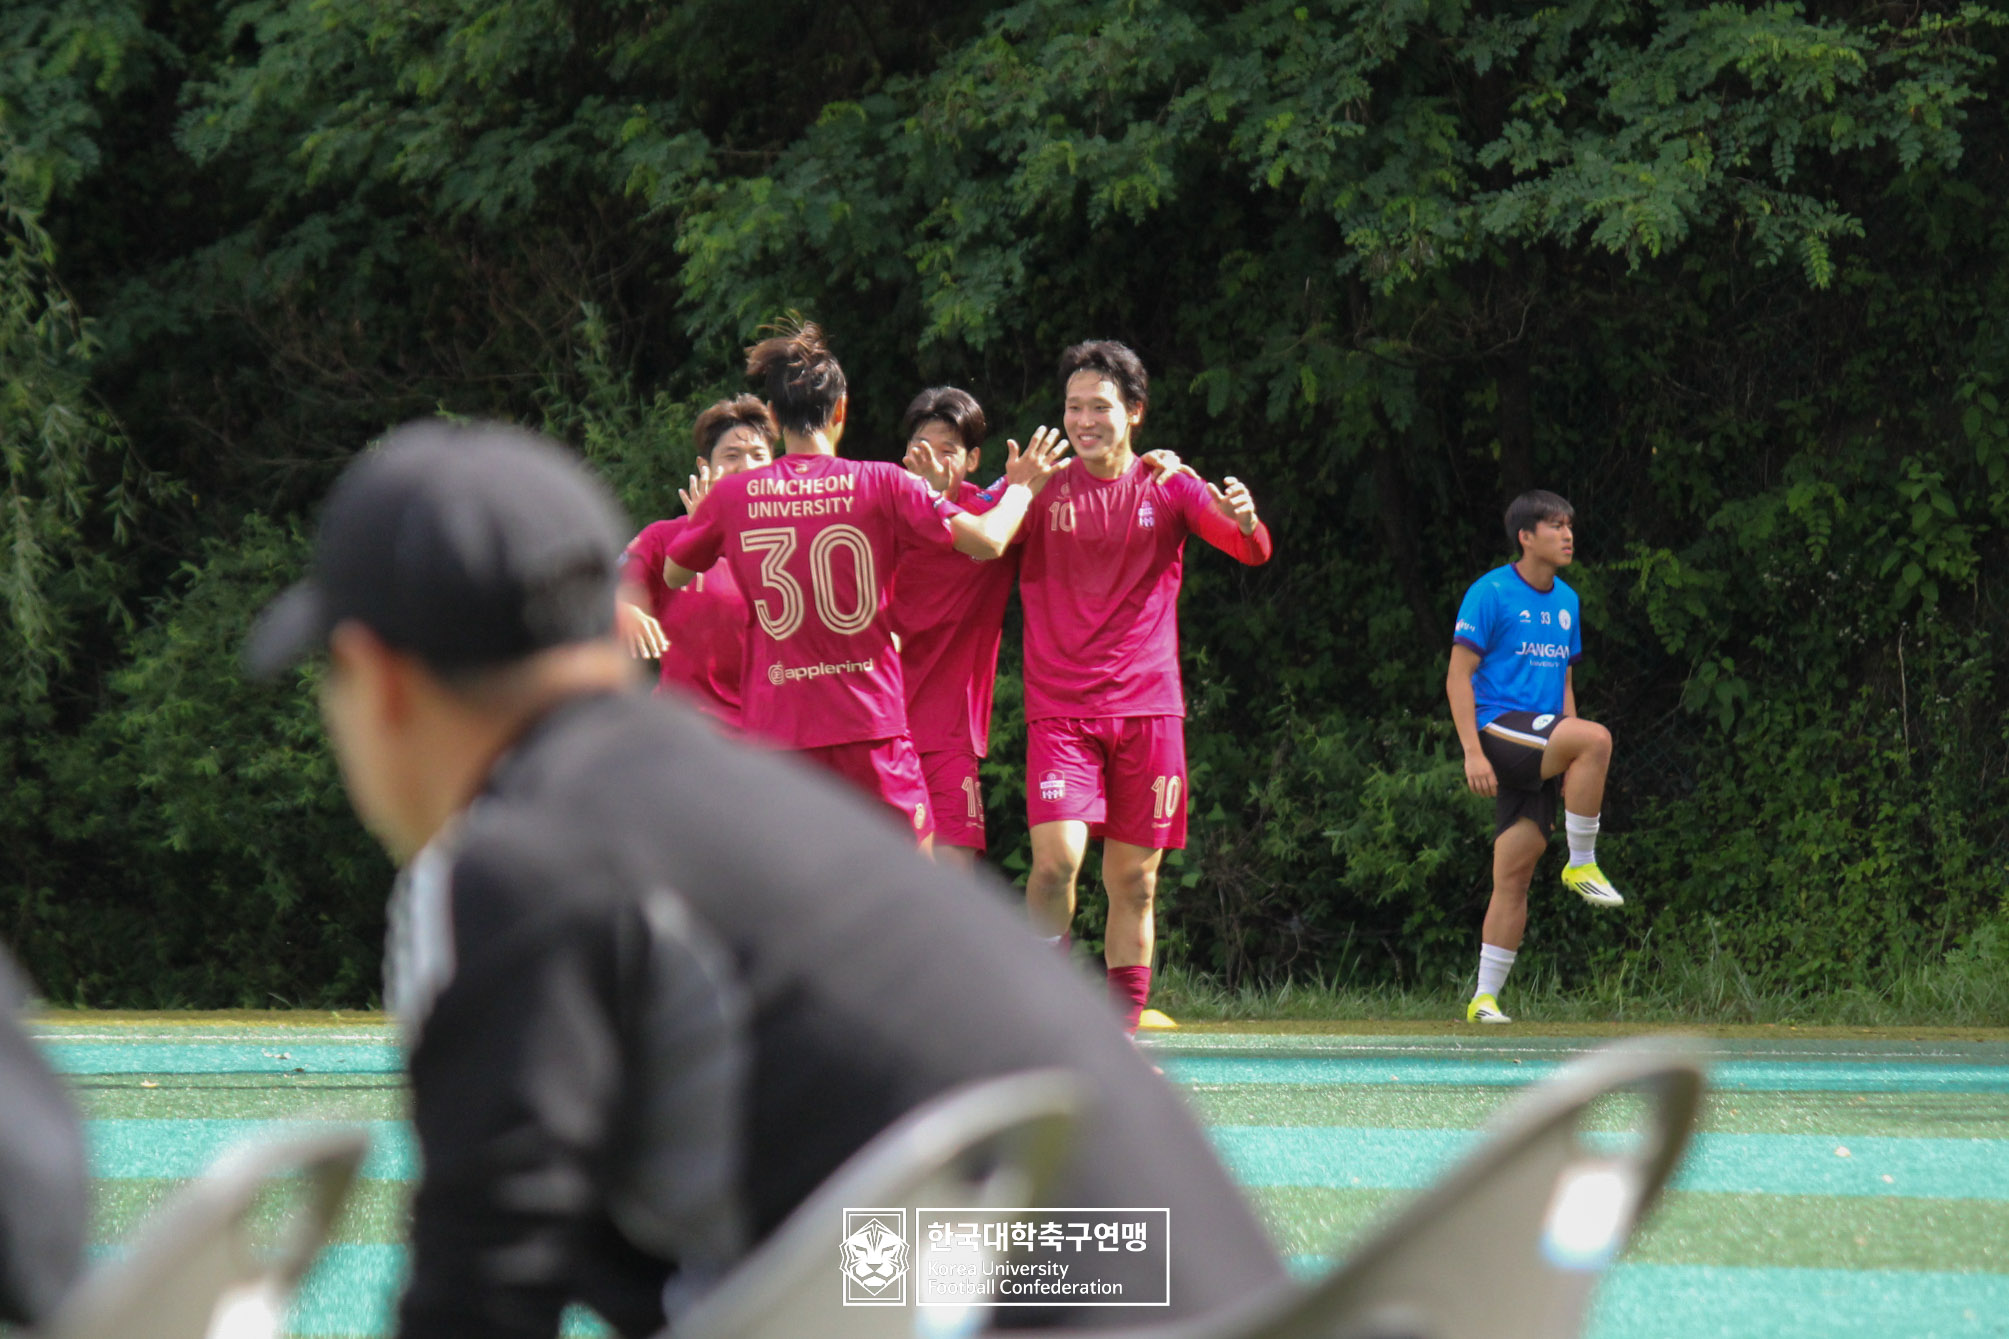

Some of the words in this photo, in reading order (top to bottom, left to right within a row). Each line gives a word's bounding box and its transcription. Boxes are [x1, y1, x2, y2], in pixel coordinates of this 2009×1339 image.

[747, 474, 854, 496] GIMCHEON
[748, 496, 853, 519] UNIVERSITY
[1049, 501, 1076, 532] 10
[740, 523, 878, 641] 30
[1151, 775, 1182, 818] 10
